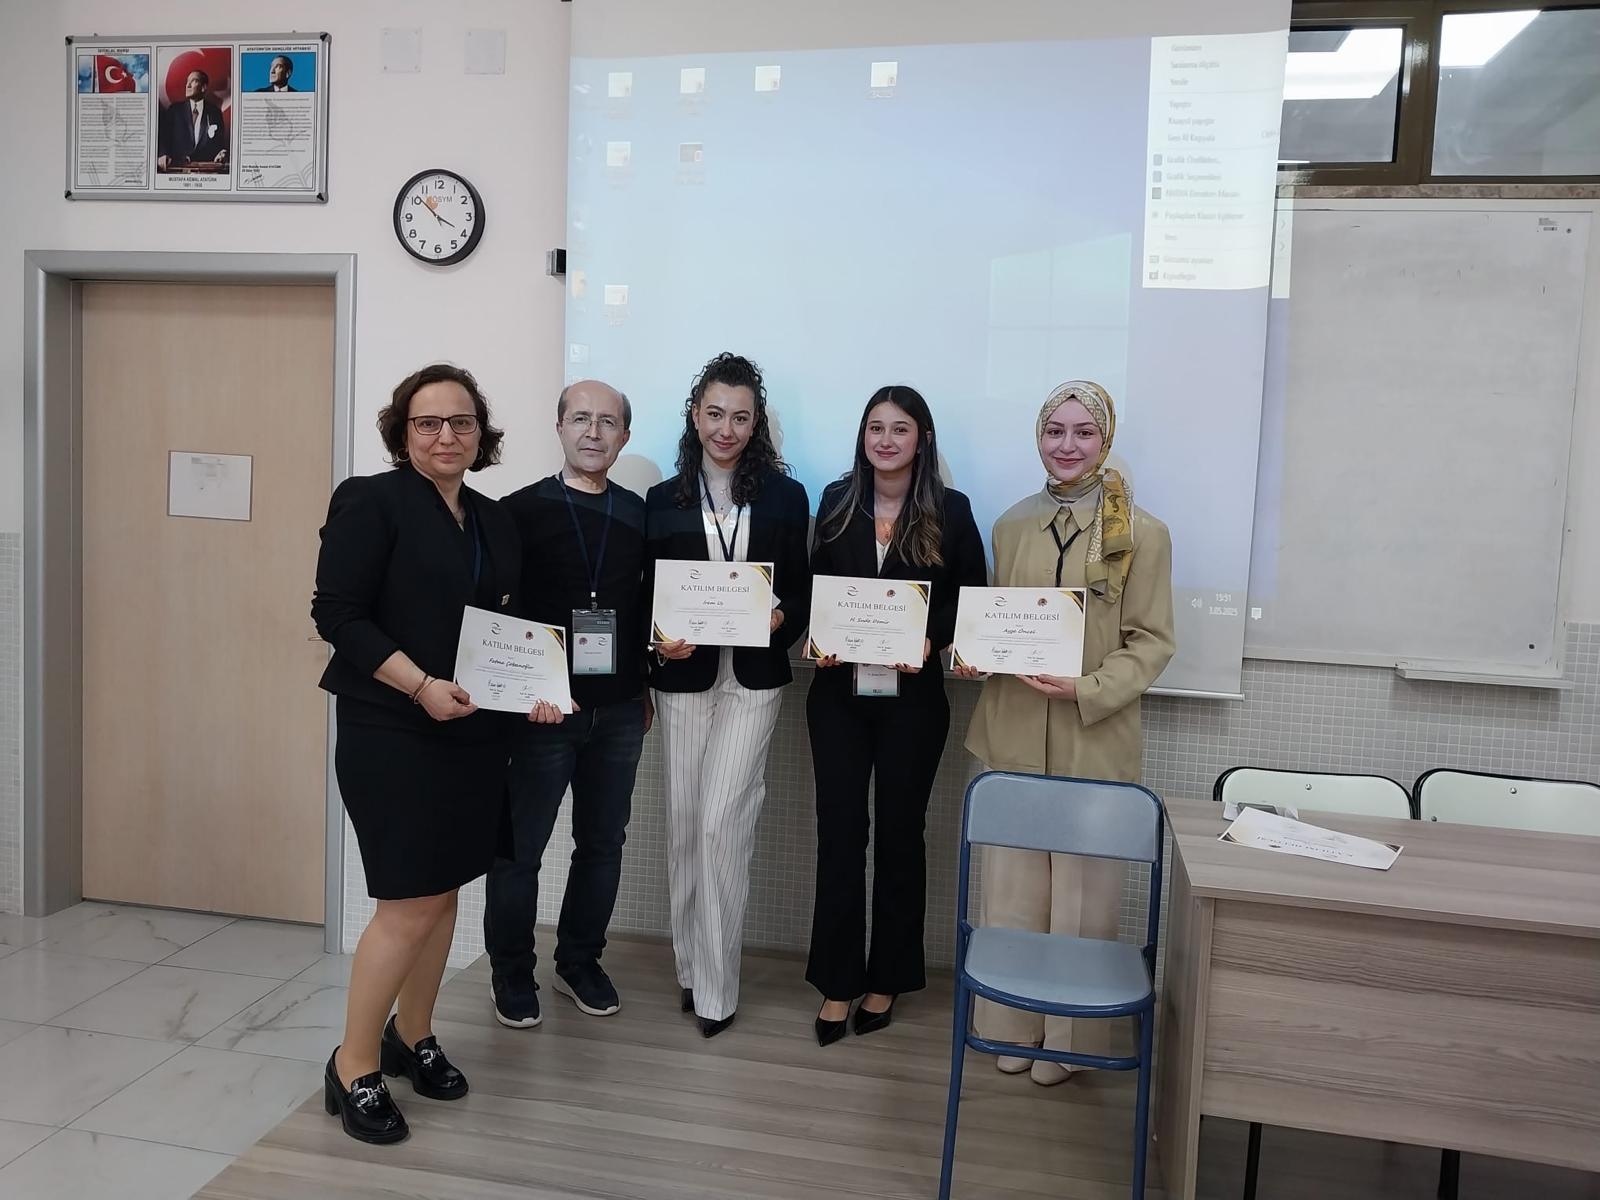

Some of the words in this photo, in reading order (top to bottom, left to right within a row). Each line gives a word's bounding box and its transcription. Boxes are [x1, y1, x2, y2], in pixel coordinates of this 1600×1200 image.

[435, 180, 445, 189] 12
[421, 185, 428, 194] 11
[411, 196, 422, 205] 10
[460, 196, 468, 205] 2
[405, 212, 413, 222] 9
[465, 212, 472, 222] 3
[409, 229, 417, 238] 8
[460, 228, 467, 238] 4
[418, 240, 426, 249] 7
[434, 244, 442, 254] 6
[450, 240, 458, 249] 5
[680, 584, 715, 592] KATILIM
[716, 585, 750, 593] BELGESİ
[837, 601, 872, 610] KATILIM
[873, 603, 906, 612] BELGESİ
[984, 612, 1021, 620] KATILIM
[1023, 612, 1060, 621] BELGESİ
[482, 639, 513, 653] KATILIM
[513, 644, 545, 657] BELGESİ
